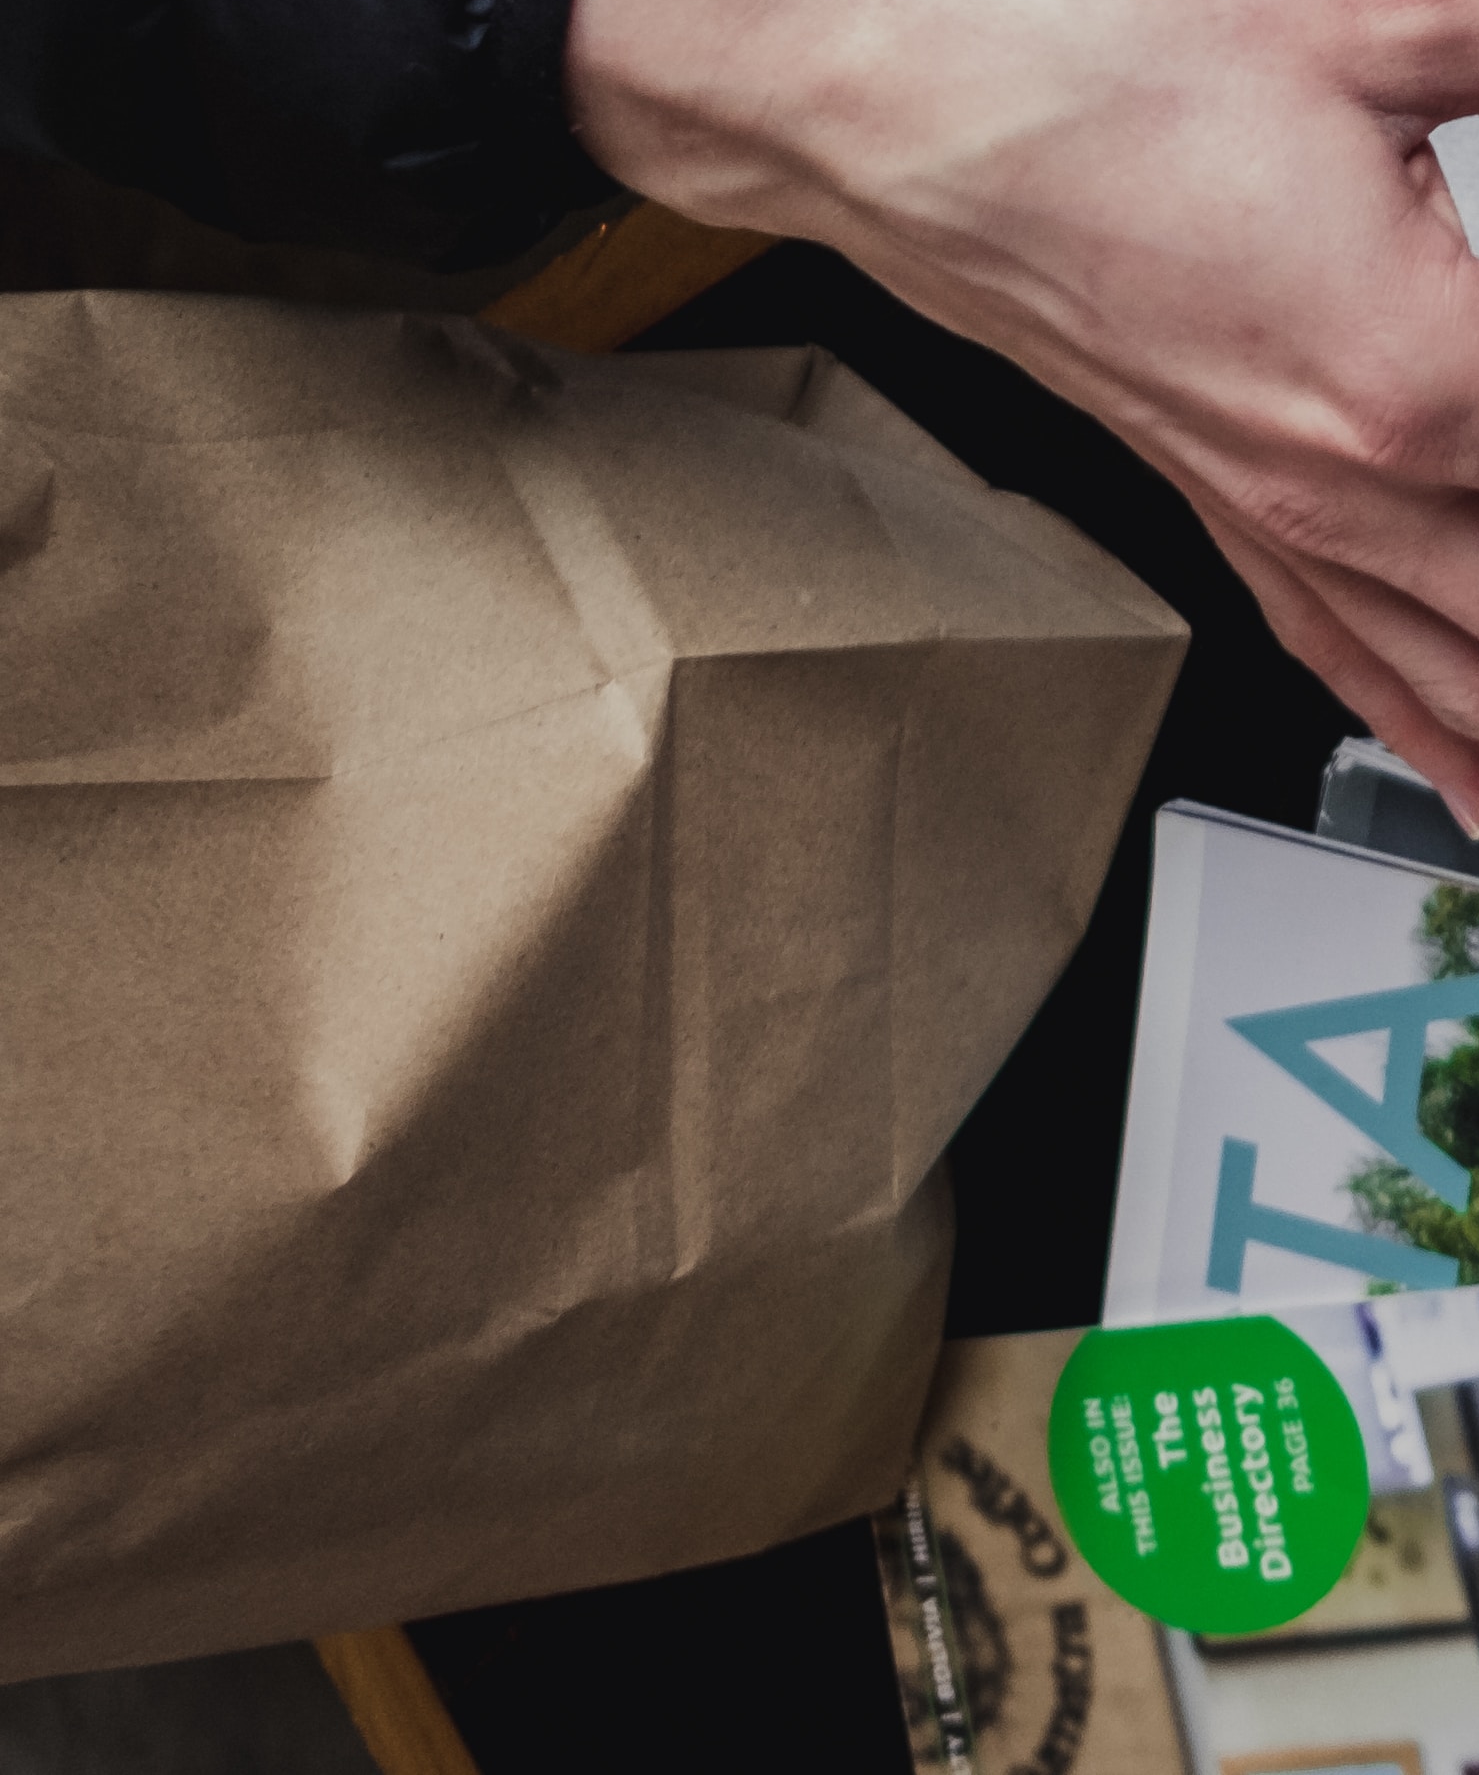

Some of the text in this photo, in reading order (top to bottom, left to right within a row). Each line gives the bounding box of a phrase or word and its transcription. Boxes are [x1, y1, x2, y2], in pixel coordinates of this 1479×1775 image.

[1082, 1397, 1121, 1513] ALSO IN
[1110, 1393, 1158, 1557] THIS ISSUE:
[1153, 1391, 1188, 1471] The
[1192, 1386, 1250, 1569] Business
[1231, 1383, 1293, 1582] Directory
[1273, 1377, 1315, 1493] PAGE 36
